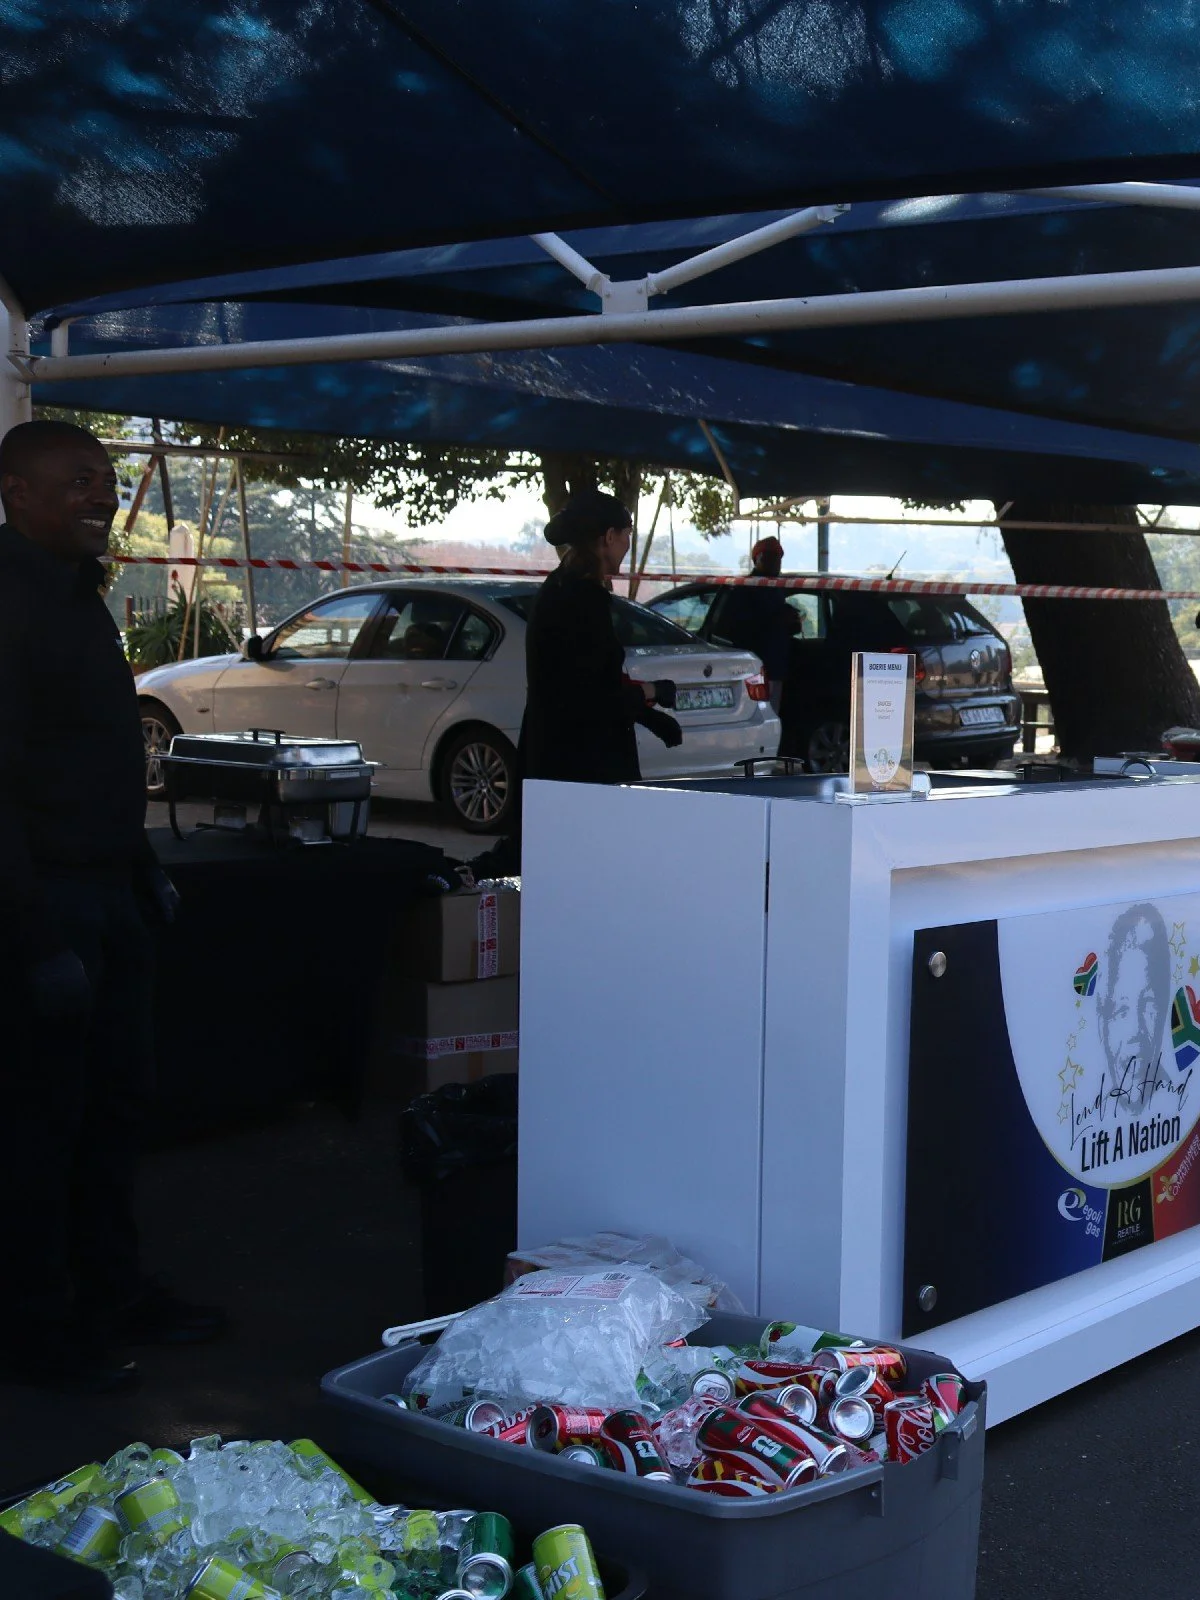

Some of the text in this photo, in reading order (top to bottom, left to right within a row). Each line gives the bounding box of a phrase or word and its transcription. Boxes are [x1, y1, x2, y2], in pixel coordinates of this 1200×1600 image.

[868, 663, 902, 671] BOERIE MENU
[1070, 1072, 1106, 1151] Lend
[1137, 1052, 1193, 1112] Hand
[1081, 1113, 1181, 1172] Lift A Nation
[1082, 1204, 1104, 1226] egoli
[1117, 1195, 1142, 1228] RG
[1085, 1221, 1101, 1238] gas
[1117, 1223, 1141, 1239] REATILE
